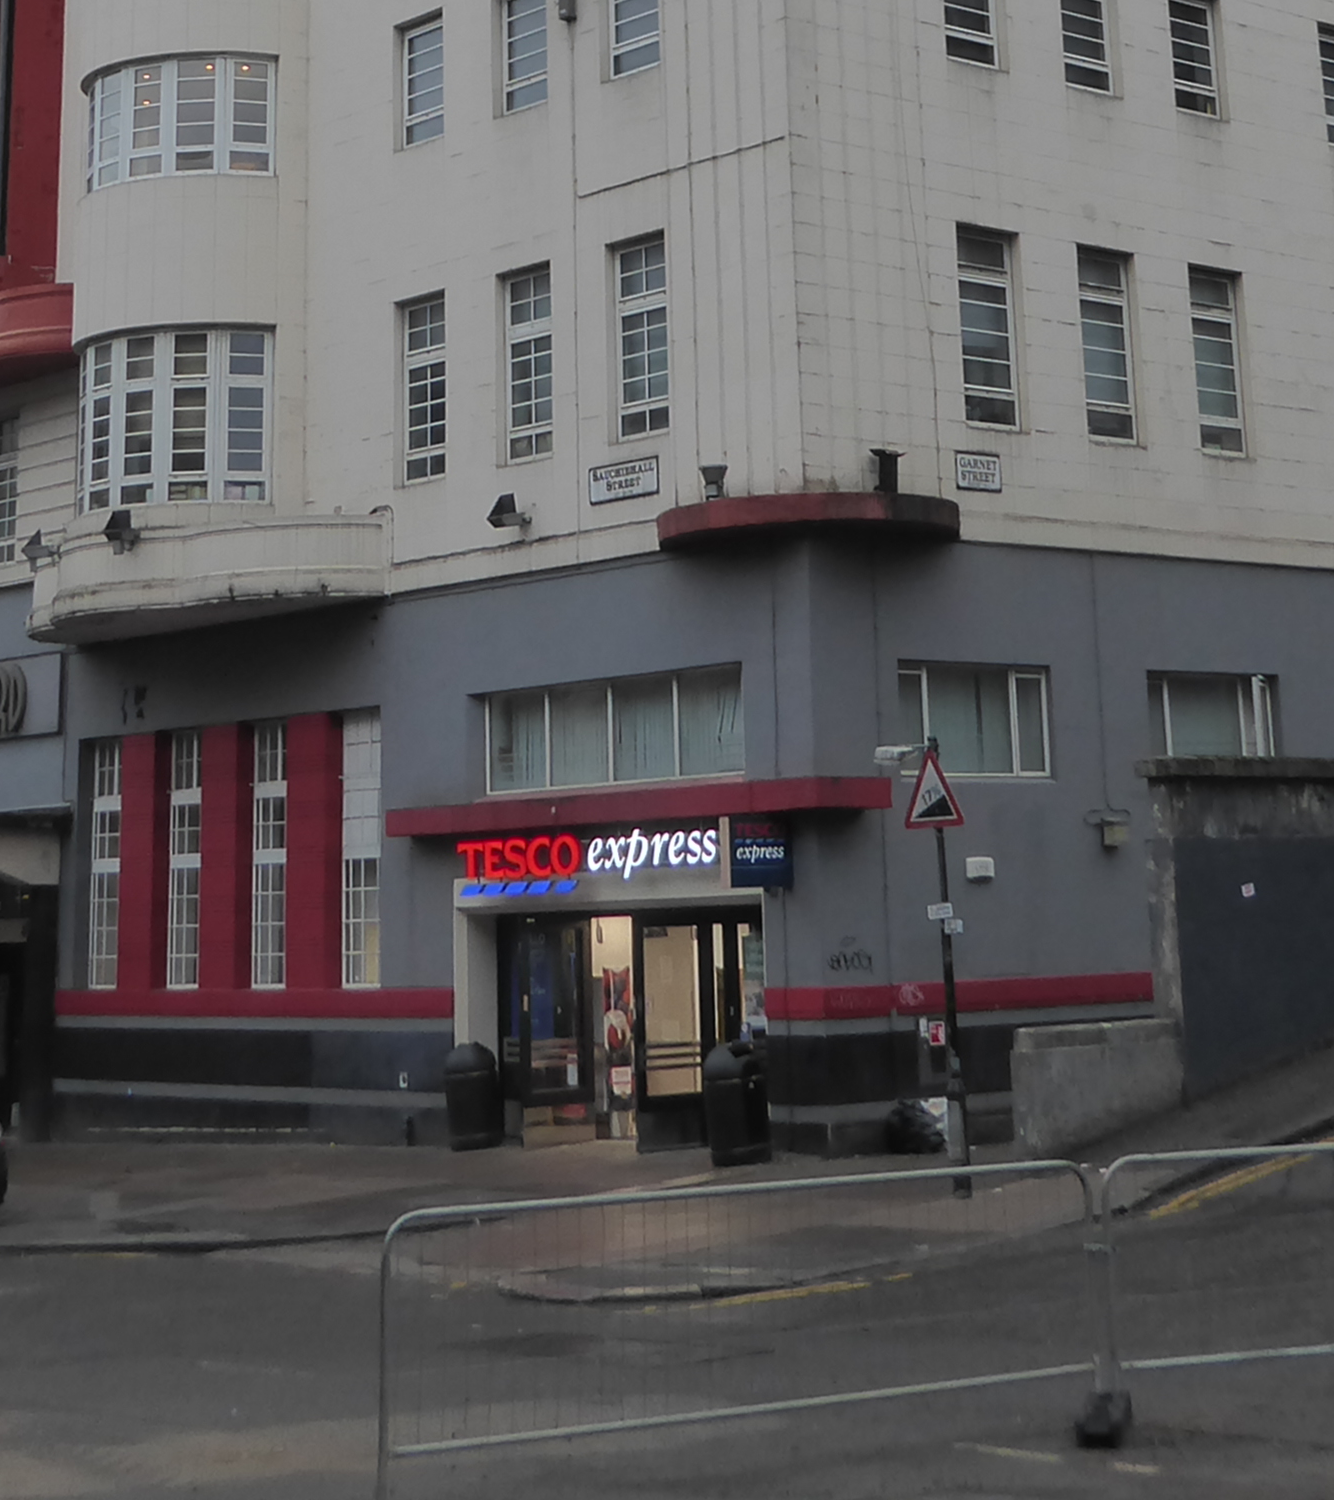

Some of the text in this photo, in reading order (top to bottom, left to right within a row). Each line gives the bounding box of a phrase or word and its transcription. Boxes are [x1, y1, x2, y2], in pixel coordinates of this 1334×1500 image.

[959, 457, 997, 471] GARNET
[606, 475, 641, 492] STREET
[961, 470, 996, 484] STREET
[457, 828, 718, 879] TESCO express
[736, 844, 786, 864] express
